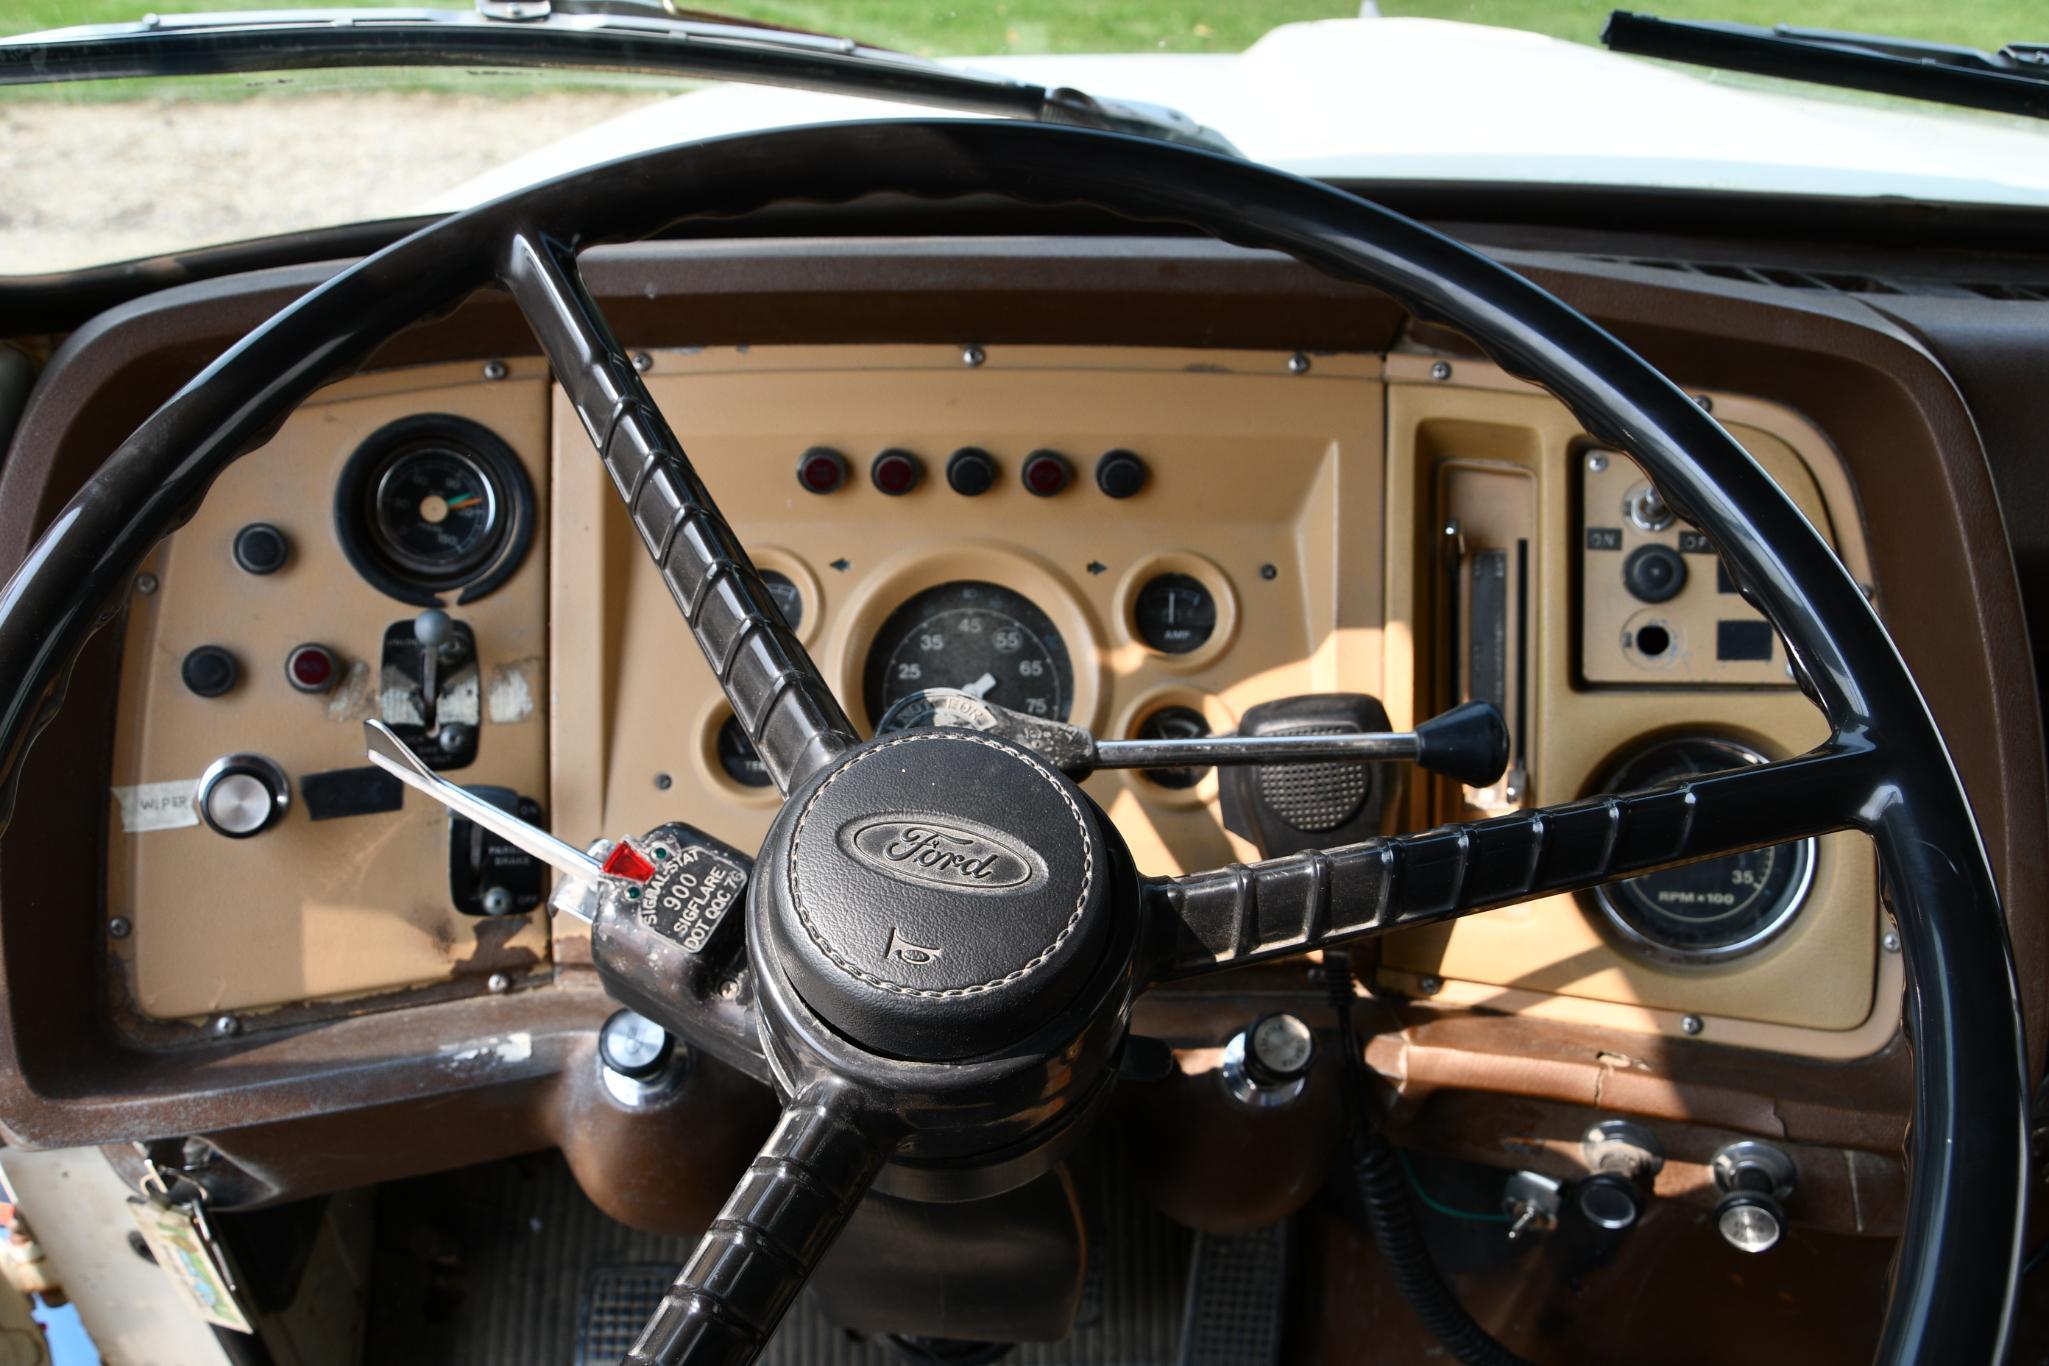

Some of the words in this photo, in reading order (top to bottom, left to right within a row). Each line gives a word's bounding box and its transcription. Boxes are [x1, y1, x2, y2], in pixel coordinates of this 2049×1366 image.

[958, 618, 983, 633] 45
[920, 634, 944, 650] 35
[996, 633, 1018, 649] 55
[1164, 629, 1191, 640] AMP
[898, 663, 922, 680] 25
[1019, 660, 1043, 677] 65
[944, 696, 983, 722] FOR
[1026, 697, 1048, 714] 75
[883, 826, 999, 879] Ford
[1731, 870, 1754, 885] 35
[663, 873, 697, 911] 900
[1658, 891, 1695, 904] RPM
[1707, 893, 1735, 905] 100
[673, 866, 727, 936] SIGFLARE
[683, 918, 711, 950] DOT
[723, 870, 745, 889] 76
